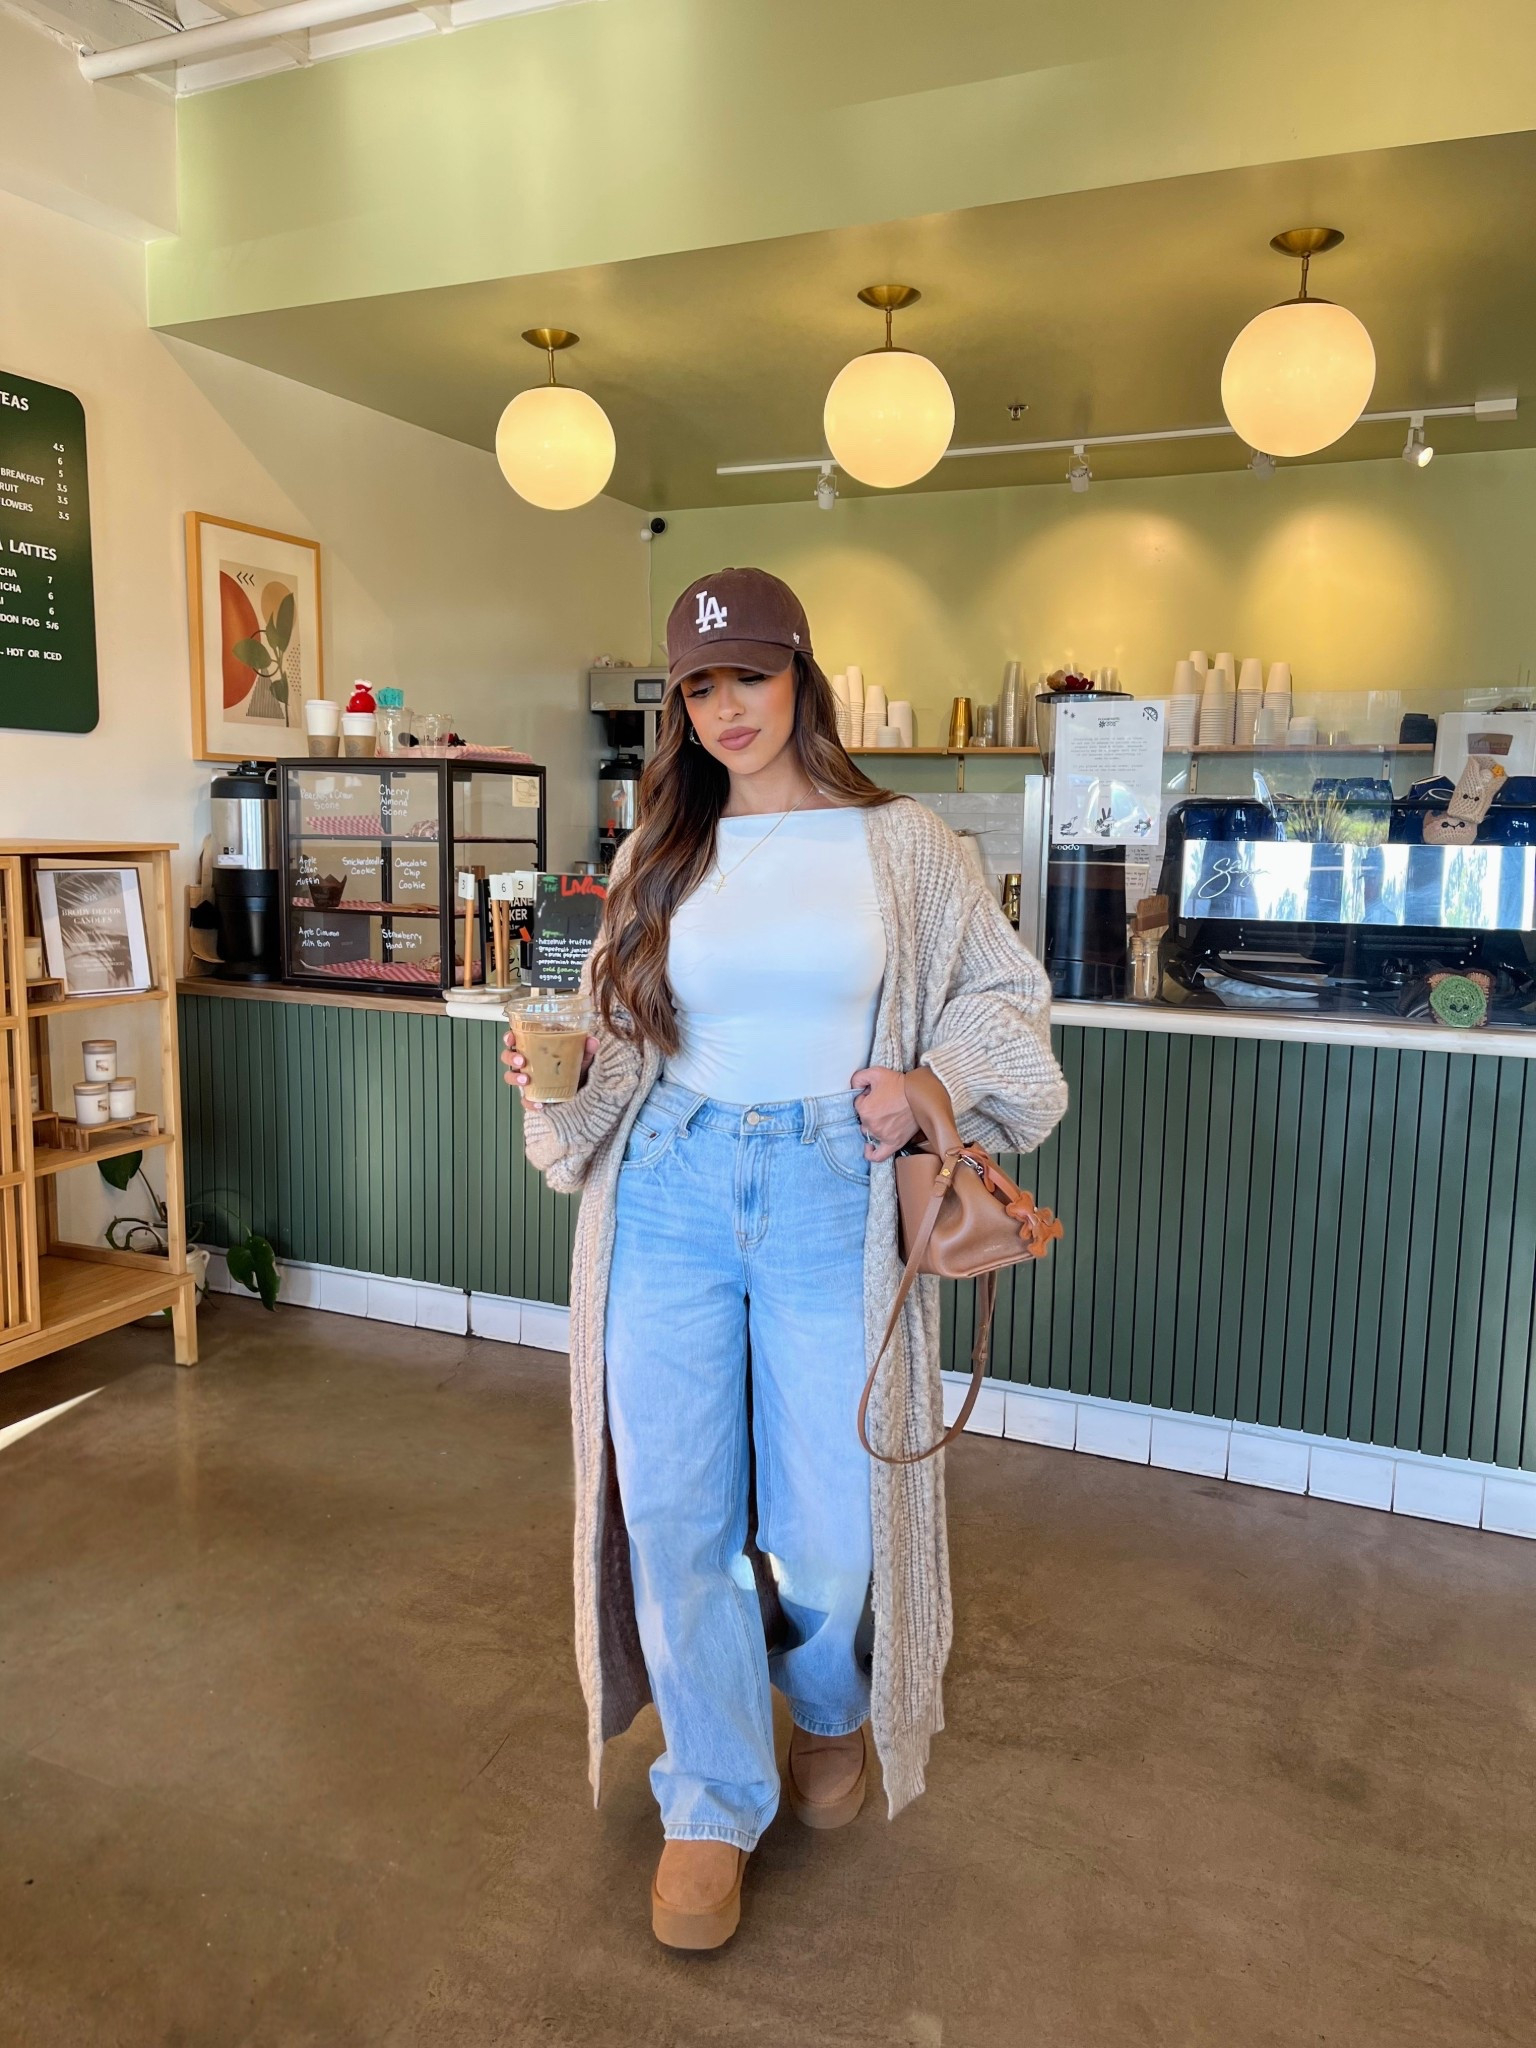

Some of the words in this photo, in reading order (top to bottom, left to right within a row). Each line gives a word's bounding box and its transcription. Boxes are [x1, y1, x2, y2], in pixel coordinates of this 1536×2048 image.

[0, 390, 29, 411] EAS
[52, 442, 65, 453] 4.5
[57, 457, 63, 465] 6
[58, 469, 64, 478] 5
[0, 467, 45, 486] BREAKFAST
[57, 483, 68, 493] 3.5
[57, 495, 69, 505] 3.5
[58, 511, 70, 521] 3.5
[9, 539, 57, 561] LATTES
[47, 576, 53, 584] 7
[48, 592, 54, 600] 6
[49, 607, 55, 615] 6
[695, 590, 728, 634] LA
[22, 616, 40, 628] FOG
[45, 621, 60, 630] 5/6
[6, 647, 24, 657] HOT
[27, 649, 40, 659] OR
[43, 651, 62, 661] ICED
[378, 784, 410, 800] Cherry
[380, 798, 408, 807] Almond
[381, 806, 408, 816] Scone
[299, 855, 318, 867] Apple
[394, 858, 428, 868] Chocolate
[351, 867, 376, 875] Cookie
[403, 868, 421, 878] Chip
[398, 880, 426, 890] Cookie
[501, 882, 507, 893] 6
[517, 881, 524, 891] 5
[298, 926, 315, 939] Apple
[381, 928, 423, 945] Strawberry
[385, 942, 403, 950] Hand
